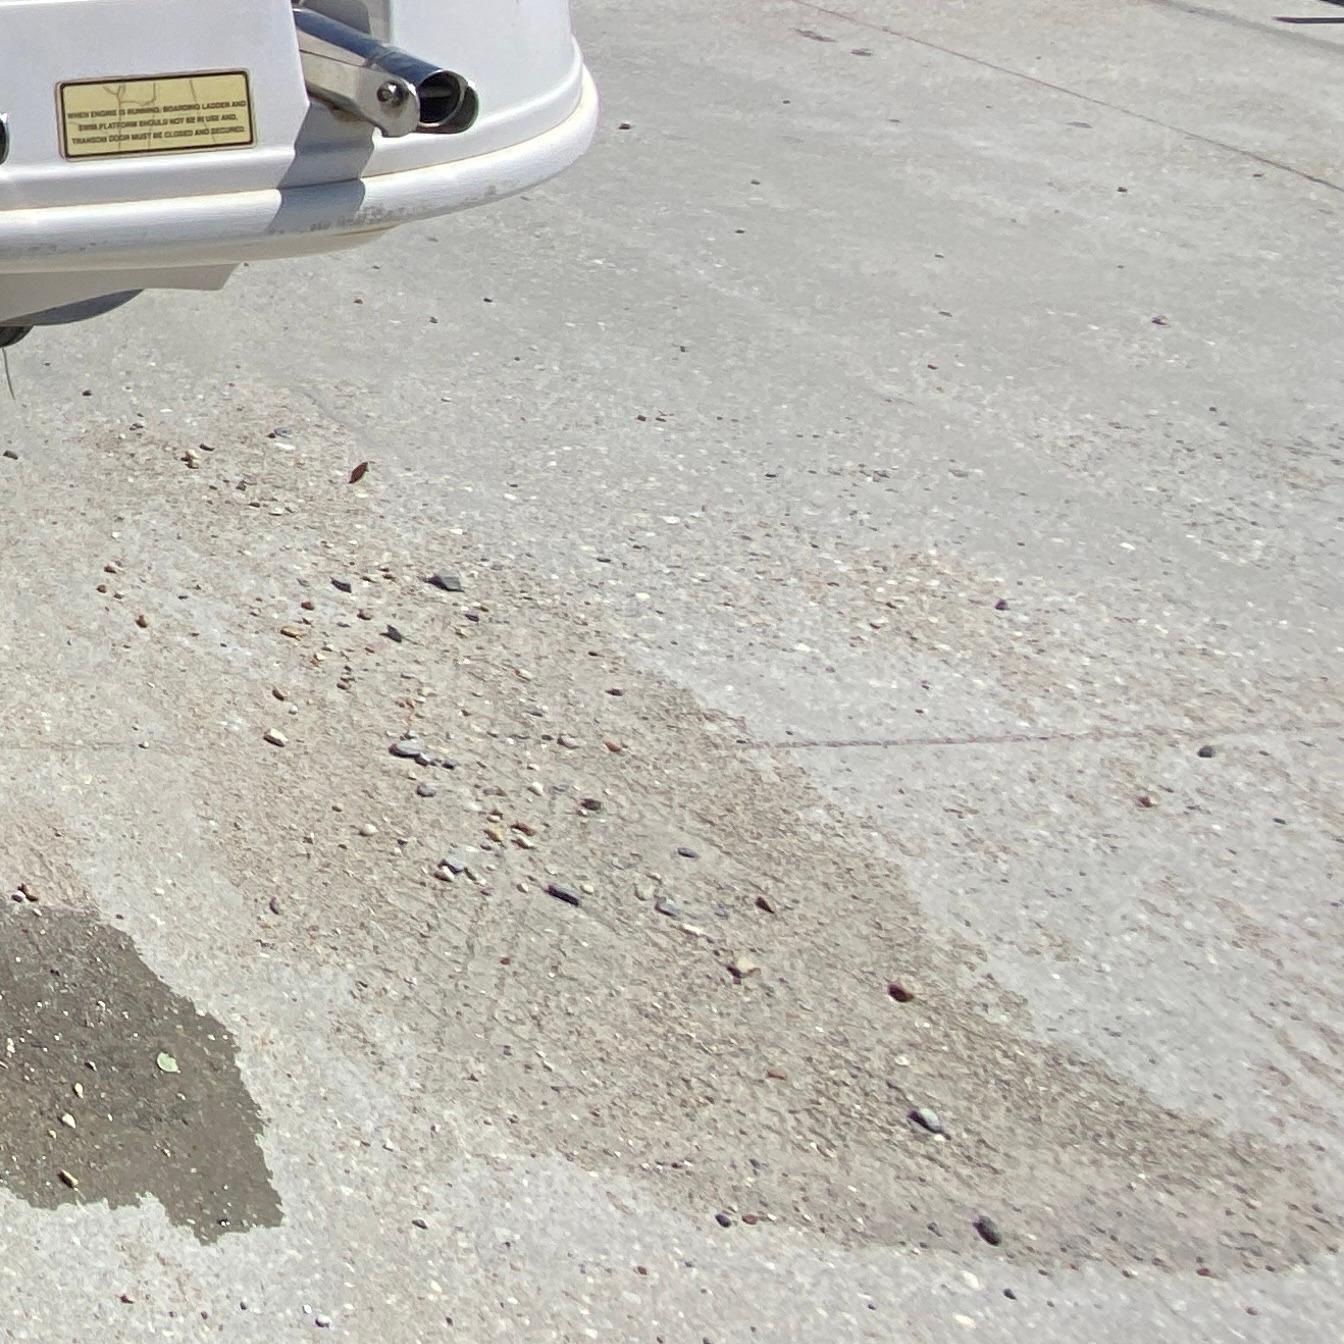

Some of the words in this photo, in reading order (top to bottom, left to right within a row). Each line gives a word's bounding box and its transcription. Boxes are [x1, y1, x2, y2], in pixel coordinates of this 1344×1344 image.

[163, 104, 200, 112] BOARDING
[202, 101, 230, 110] LADDER
[98, 121, 137, 130] PLATFORM
[139, 118, 168, 127] SHOULD
[170, 117, 184, 125] NOT
[108, 134, 130, 142] DOOR
[131, 132, 151, 140] MUST
[153, 131, 162, 139] BE
[164, 130, 193, 138] CLOSED
[195, 128, 209, 136] AND
